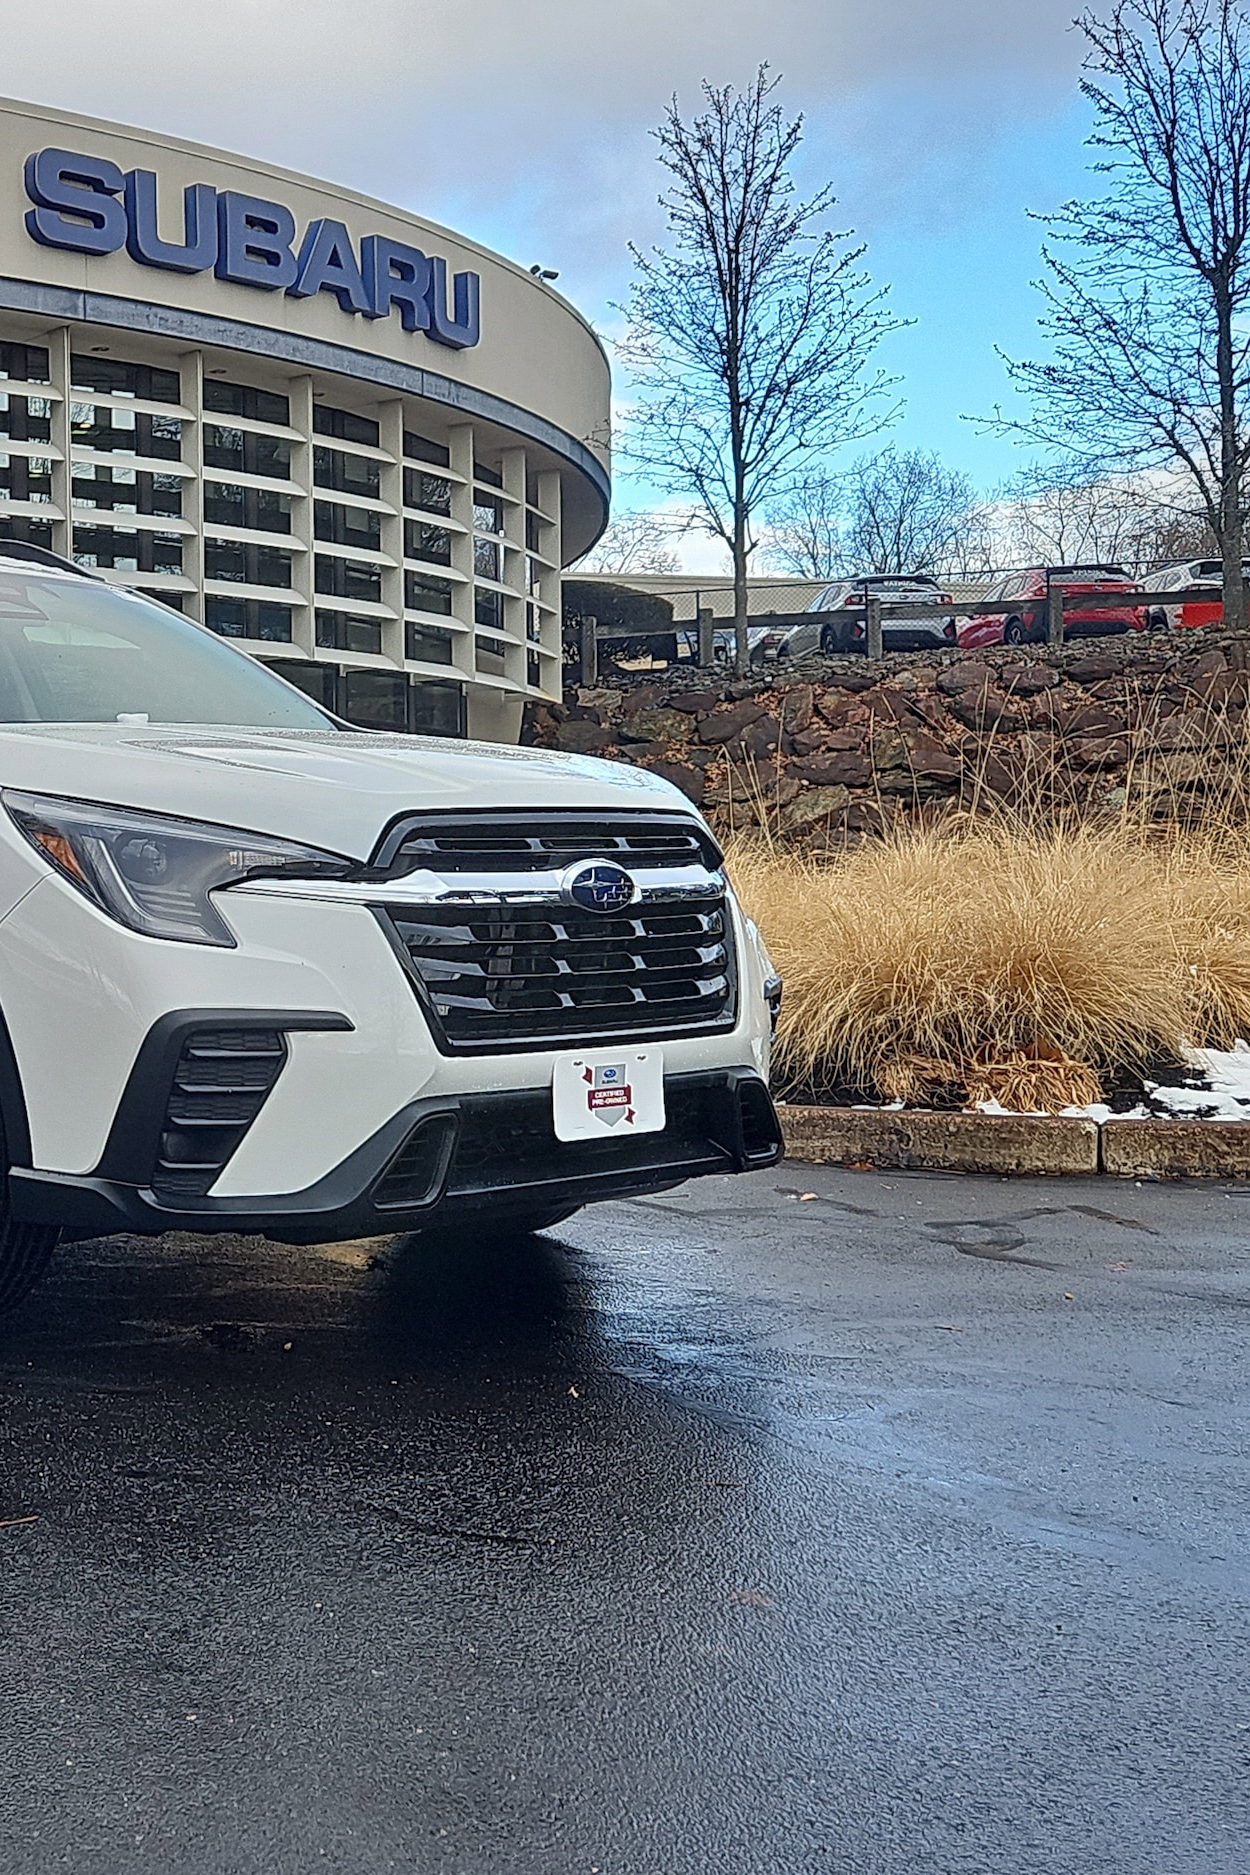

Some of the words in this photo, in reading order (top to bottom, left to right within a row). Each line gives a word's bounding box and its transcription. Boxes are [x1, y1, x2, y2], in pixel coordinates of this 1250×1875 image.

[23, 147, 481, 350] SUBARU
[594, 1089, 625, 1099] CERTIFIED
[591, 1096, 628, 1106] PRE-OWNED
